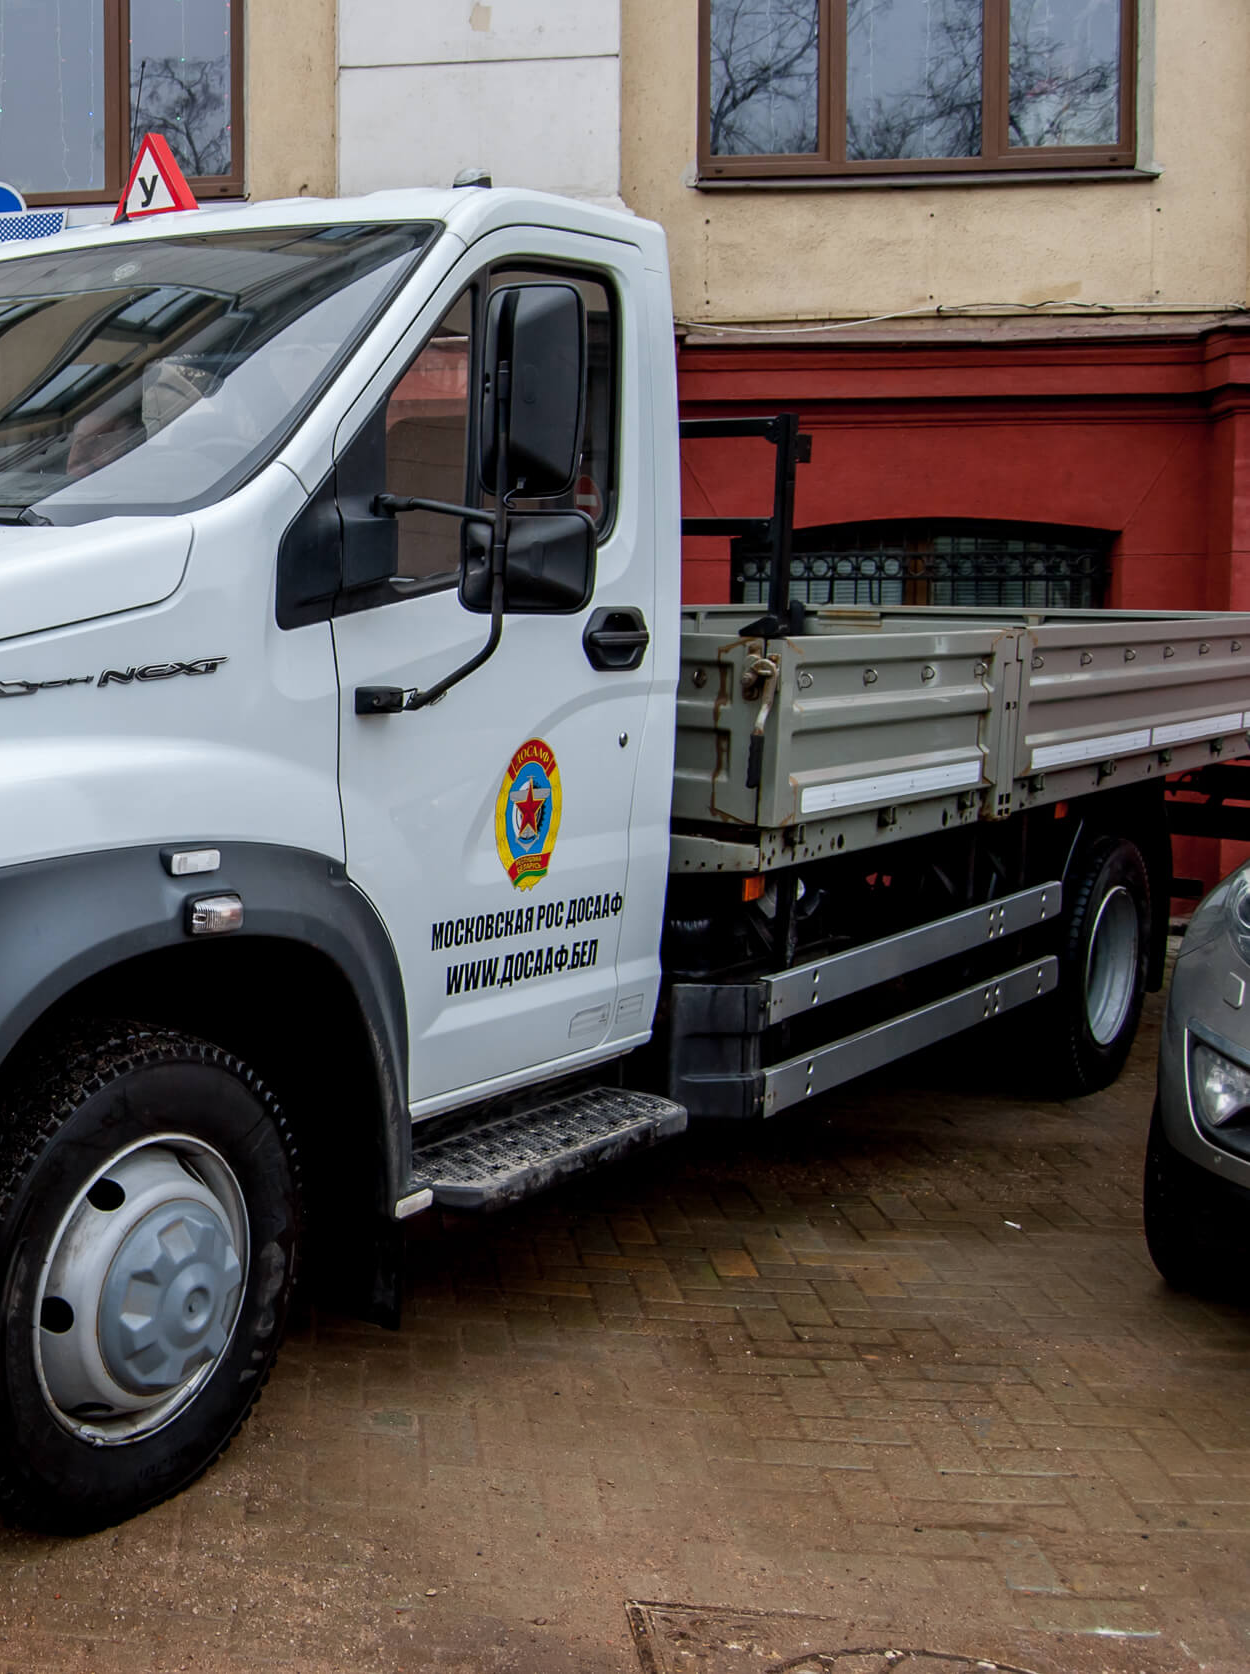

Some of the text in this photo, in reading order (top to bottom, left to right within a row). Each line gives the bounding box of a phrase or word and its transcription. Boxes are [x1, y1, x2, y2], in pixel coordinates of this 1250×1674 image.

[97, 656, 230, 688] NEXT
[431, 891, 623, 952] МОСКОВСКАЯ РОС ДОСААФ
[446, 938, 599, 996] WWW.ДОСААФ.БЕЛ
